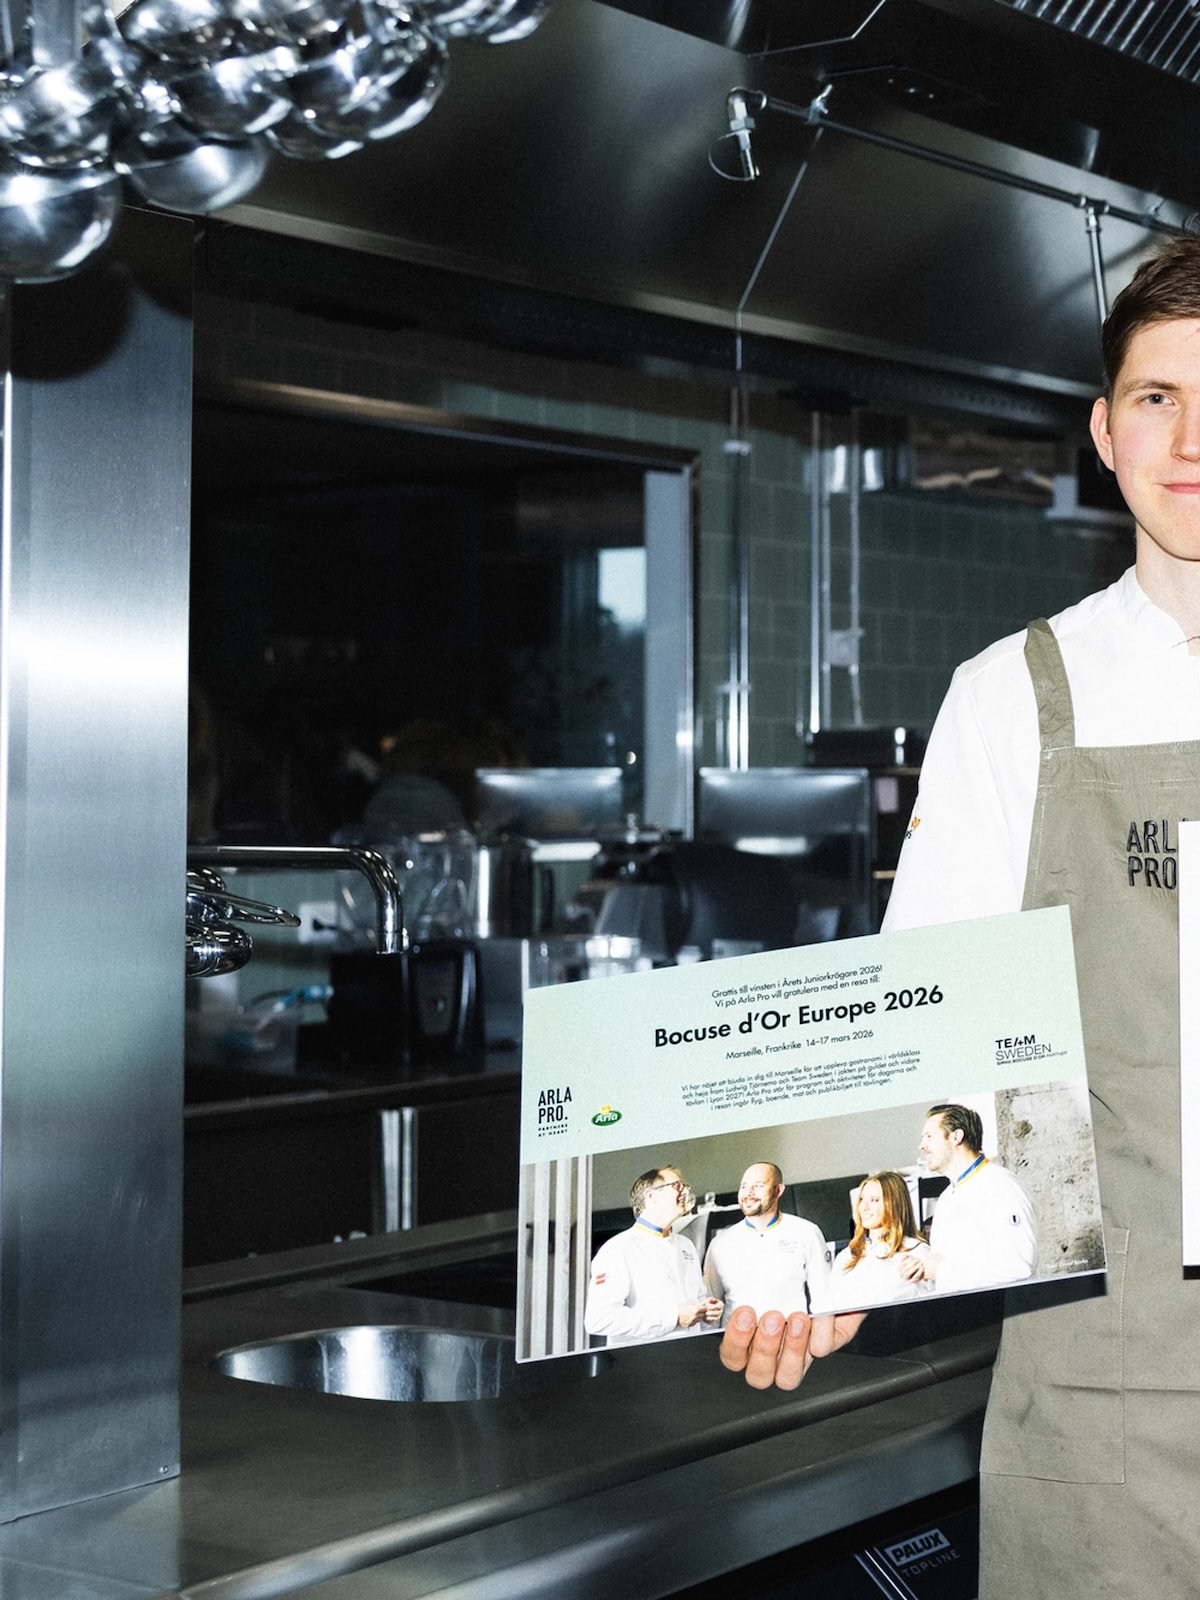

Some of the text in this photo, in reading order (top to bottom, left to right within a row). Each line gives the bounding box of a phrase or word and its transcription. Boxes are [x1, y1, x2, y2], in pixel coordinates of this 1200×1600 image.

[1126, 817, 1188, 854] ARL
[1128, 856, 1177, 890] PRO
[711, 988, 737, 999] Grattis
[738, 986, 748, 994] till
[749, 983, 775, 993] vinsten
[782, 978, 802, 987] Årets
[803, 970, 858, 984] Juniorkrögare
[858, 964, 882, 975] 2026!
[725, 999, 736, 1007] på
[737, 996, 755, 1004] Arla
[770, 991, 782, 999] vill
[782, 987, 819, 998] gratulera
[820, 983, 838, 991] med
[654, 1022, 731, 1046] Bocuse
[798, 1000, 876, 1024] Europe
[883, 985, 943, 1010] 2026
[725, 1048, 764, 1059] Marseille,
[765, 1042, 801, 1053] Frankrike
[852, 1030, 873, 1039] 2026
[996, 1043, 1052, 1061] SWEDEN
[538, 1086, 572, 1106] ARLA
[538, 1105, 568, 1124] PRO.
[594, 1112, 618, 1123] Arla
[891, 1532, 944, 1562] PALUX
[902, 1549, 960, 1577] TOPLINE
